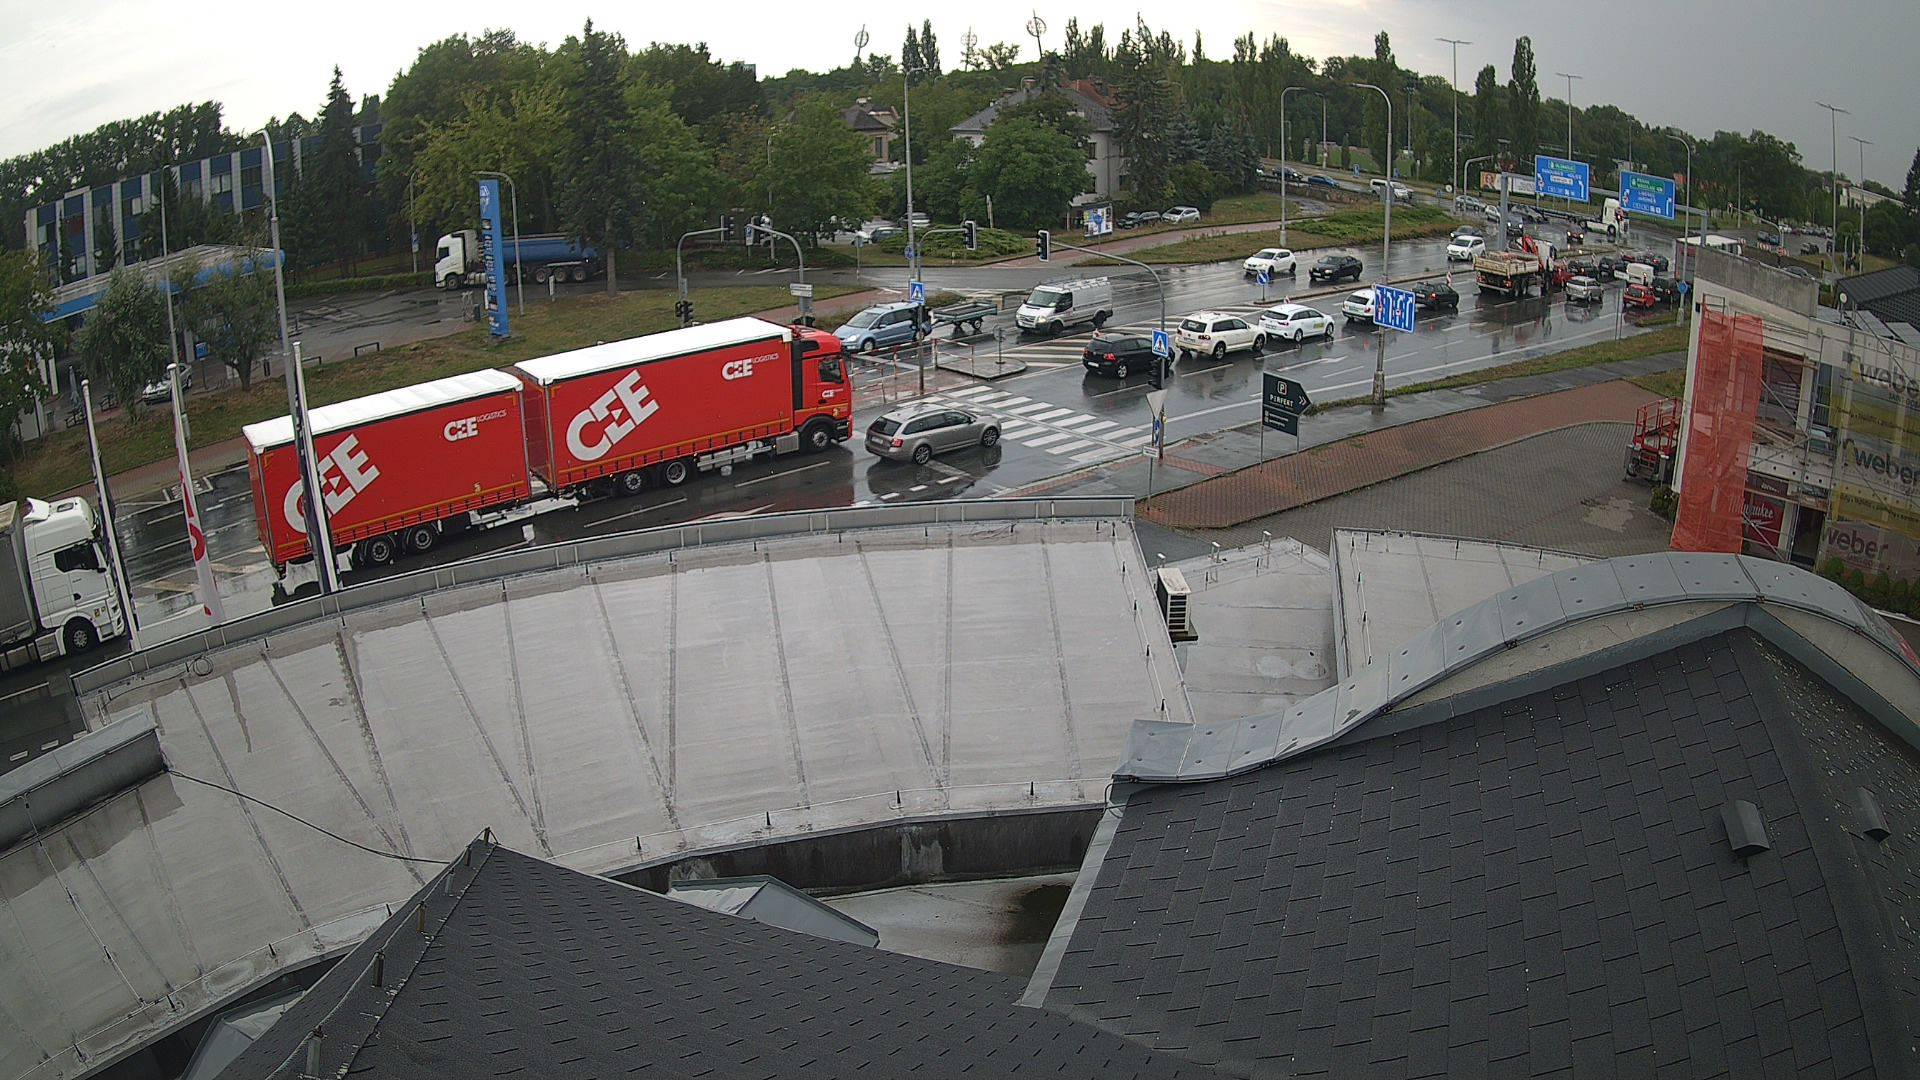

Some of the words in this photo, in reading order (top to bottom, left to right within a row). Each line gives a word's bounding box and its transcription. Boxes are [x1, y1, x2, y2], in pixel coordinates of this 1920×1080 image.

[722, 358, 753, 380] CEE
[753, 352, 779, 364] LOGISTICS
[566, 369, 660, 461] CEE
[1269, 394, 1294, 407] PERFEKT
[443, 416, 478, 442] CEE
[477, 409, 507, 423] LOGISTICS
[284, 433, 381, 534] CEE
